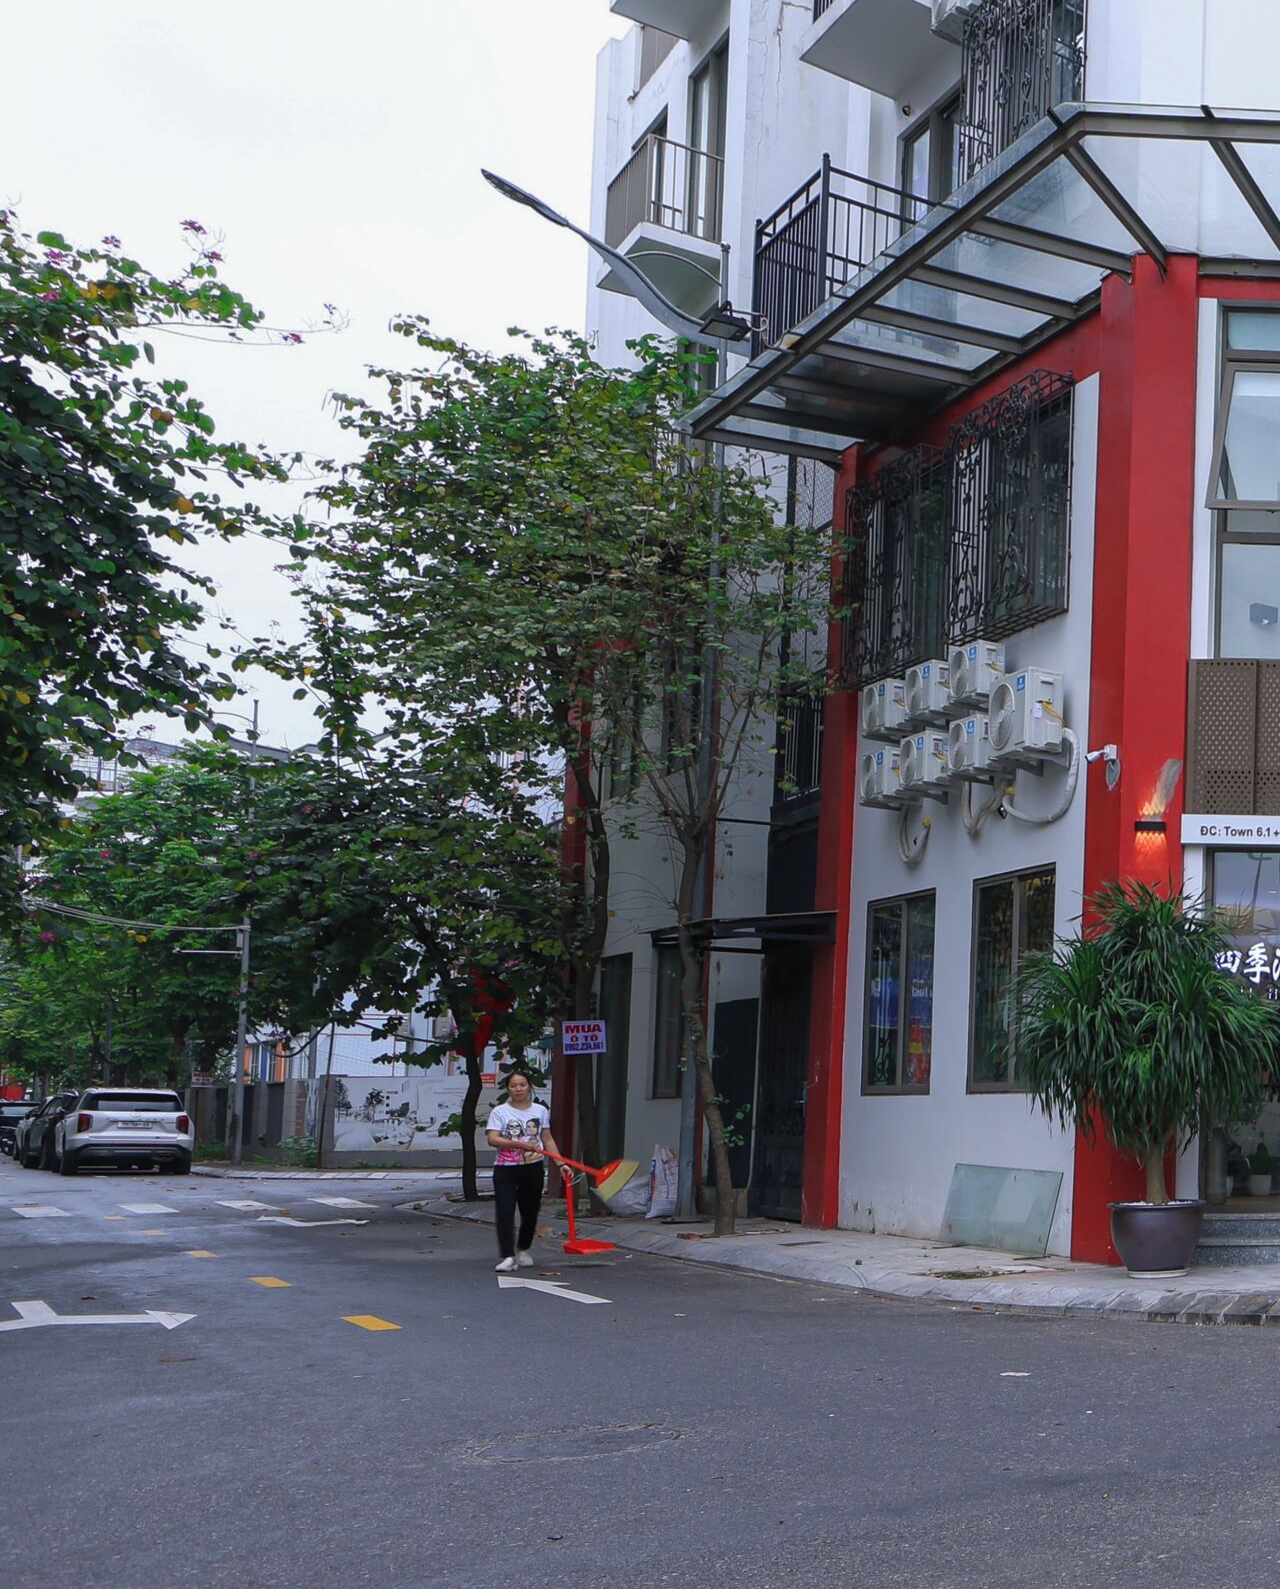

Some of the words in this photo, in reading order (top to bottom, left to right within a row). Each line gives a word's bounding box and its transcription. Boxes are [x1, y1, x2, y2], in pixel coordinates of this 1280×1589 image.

[1200, 825, 1221, 837] ĐC:
[1223, 826, 1254, 837] Town
[565, 1024, 602, 1033] MUA
